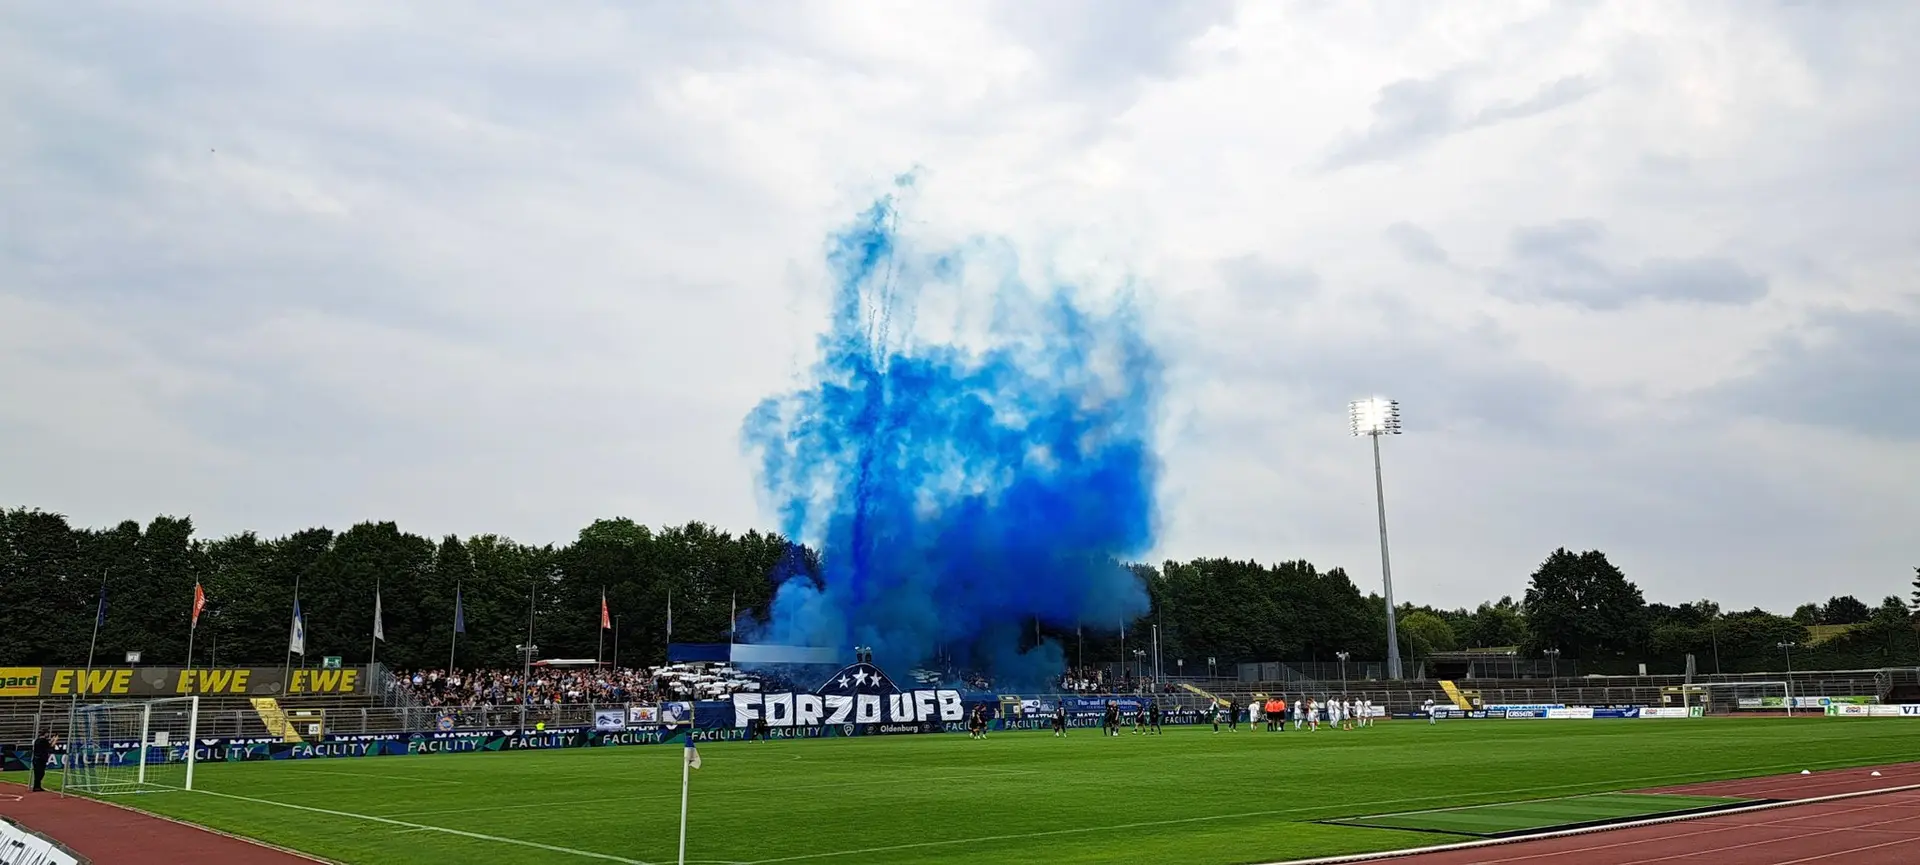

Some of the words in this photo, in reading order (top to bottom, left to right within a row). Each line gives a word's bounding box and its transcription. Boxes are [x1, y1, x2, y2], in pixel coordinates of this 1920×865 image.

[51, 669, 134, 694] EWE
[176, 669, 250, 693] EWE
[289, 669, 358, 692] EWE
[1005, 719, 1045, 729] FACILITY
[1165, 715, 1198, 724] FACILITY
[692, 729, 746, 740] FACILITY
[770, 727, 821, 737] FACILITY
[880, 725, 919, 733] Oldenburg
[509, 736, 575, 748] FACILITY
[603, 732, 663, 744] FACILITY
[292, 743, 370, 756] FACILITY
[408, 740, 478, 753] FACILITY
[47, 751, 128, 765] ACILITY
[169, 747, 255, 761] FACILITY
